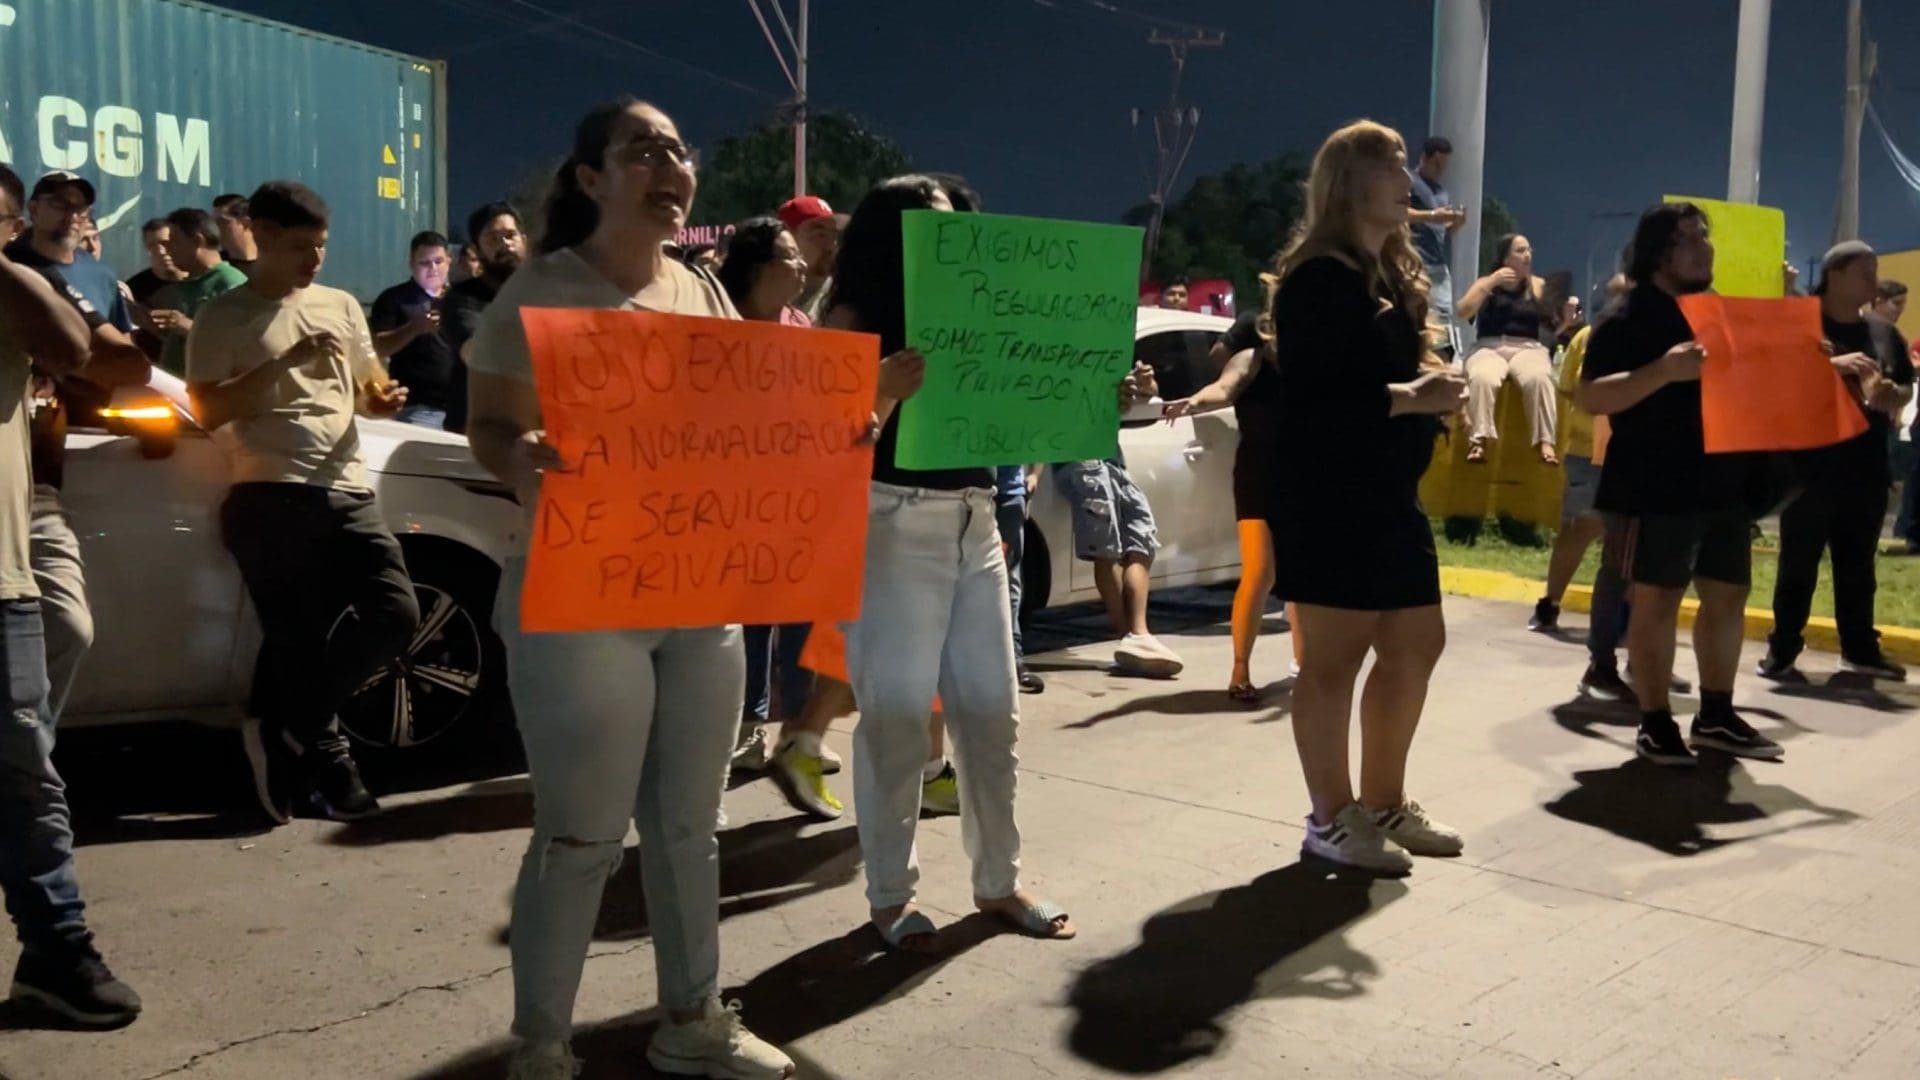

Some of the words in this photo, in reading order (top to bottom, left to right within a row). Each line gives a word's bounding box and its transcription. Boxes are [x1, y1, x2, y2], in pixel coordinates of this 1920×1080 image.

[38, 95, 211, 188] CGM
[936, 219, 1080, 273] EXIGIMOS
[688, 333, 864, 394] EXIGIMOS
[916, 327, 988, 355] SOMOS
[994, 331, 1125, 377] TRANSPORTE
[954, 360, 1072, 401] PRIVADO
[541, 497, 607, 550] DE
[632, 487, 822, 543] SERVICIO
[598, 536, 815, 600] PRIVADO
